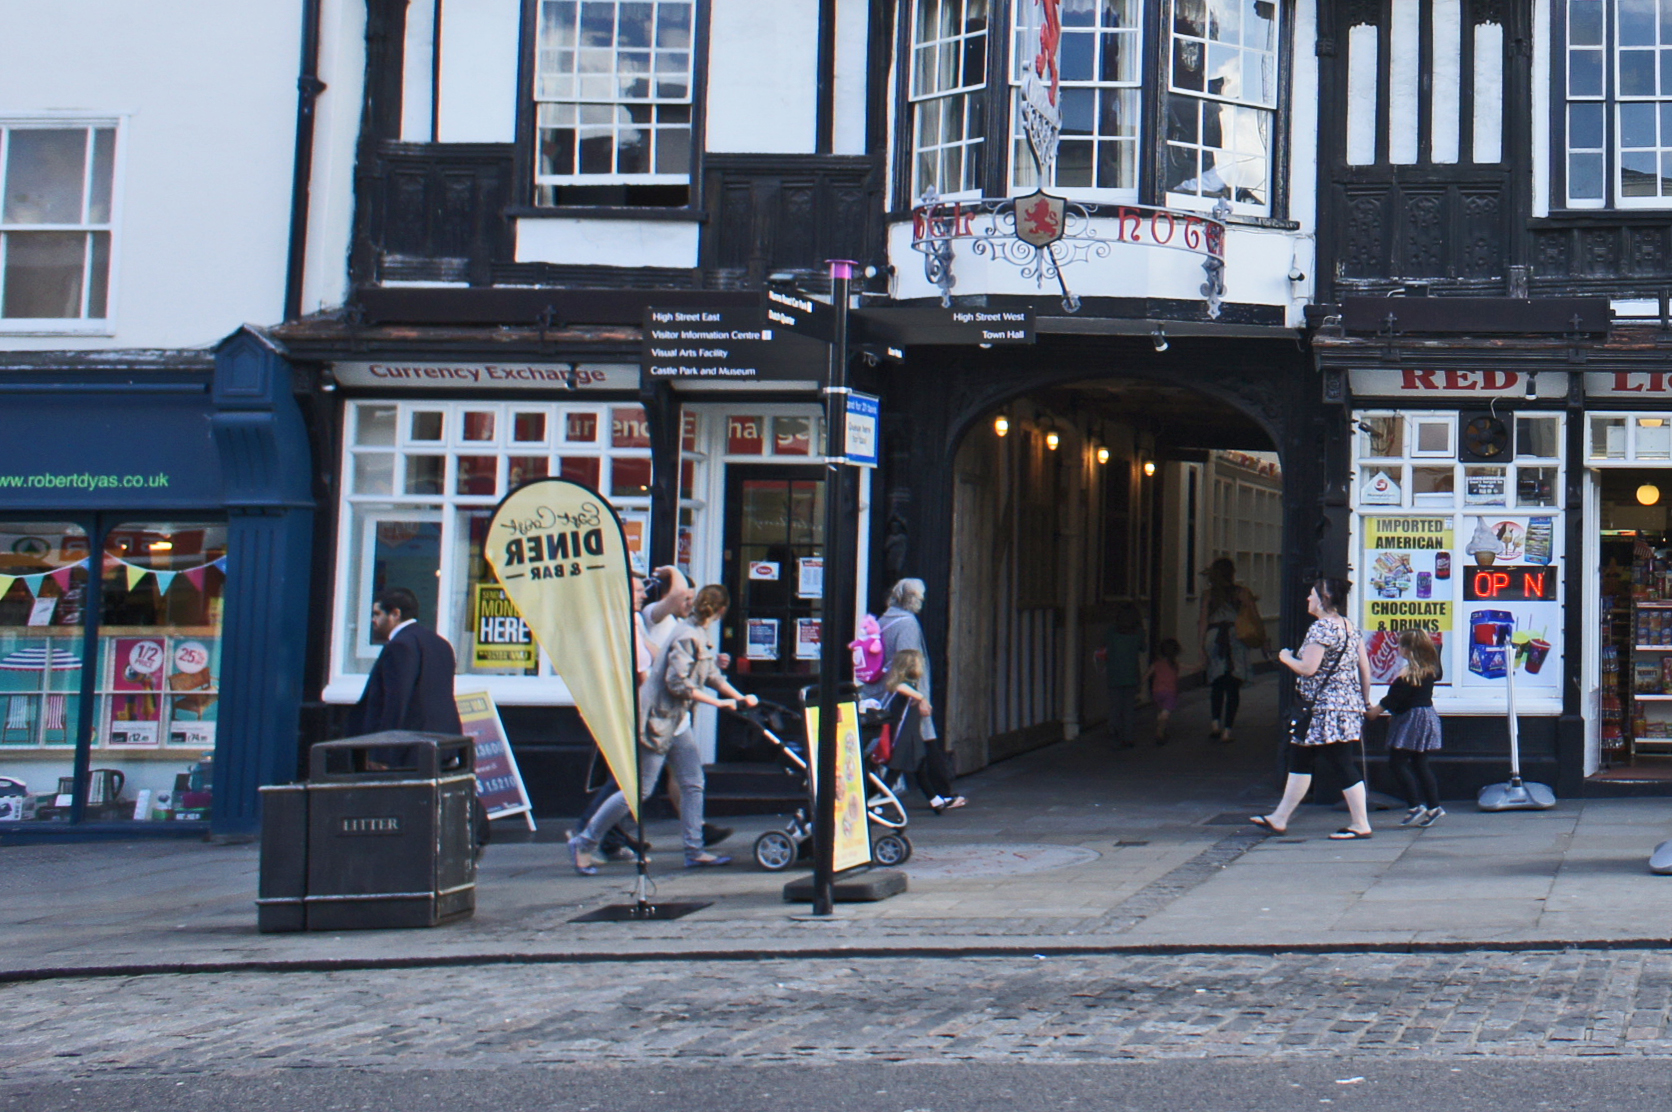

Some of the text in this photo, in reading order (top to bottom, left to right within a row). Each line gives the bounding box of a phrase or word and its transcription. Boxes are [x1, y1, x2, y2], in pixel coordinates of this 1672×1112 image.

[652, 311, 720, 323] High Street East
[953, 311, 1025, 323] High Street West
[652, 329, 760, 340] Visitor Information Centre
[982, 329, 1025, 340] Town Hall
[651, 347, 729, 359] Visual Arts Facility
[369, 364, 606, 386] Currency Exchange
[650, 365, 756, 376] Castle Park and Museum
[1400, 369, 1519, 390] RED
[1376, 519, 1443, 533] IMPORTED
[1375, 536, 1443, 550] AMERICAN
[1474, 572, 1543, 598] OPN
[1371, 602, 1446, 616] CHOCOLATE
[480, 617, 530, 643] HERE
[1377, 619, 1439, 632] & DRINKS
[343, 818, 398, 832] LITTER
